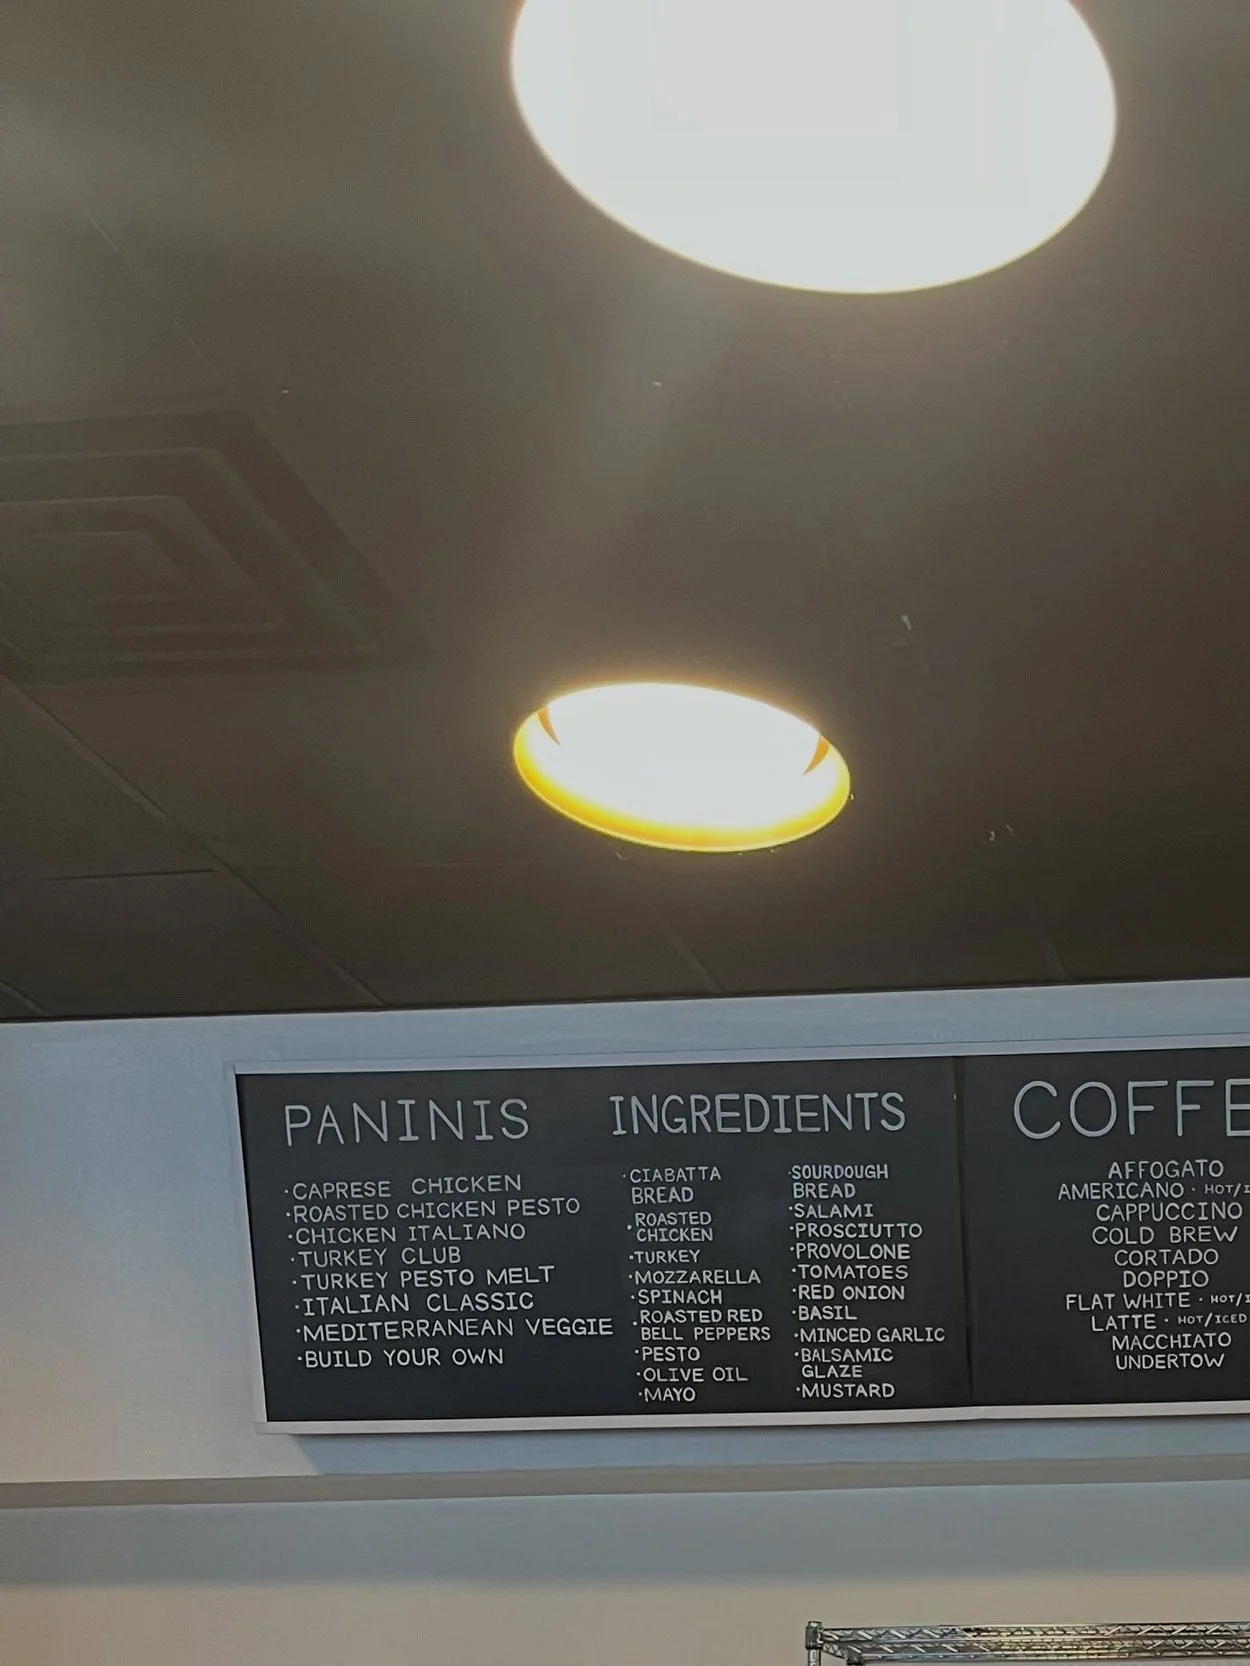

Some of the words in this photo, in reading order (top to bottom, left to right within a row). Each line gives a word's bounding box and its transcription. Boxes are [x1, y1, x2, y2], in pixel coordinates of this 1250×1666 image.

[284, 1098, 529, 1147] PANINIS
[608, 1092, 906, 1136] INGREDIENTS
[629, 1166, 722, 1184] CIABATTA
[791, 1163, 889, 1180] SOURDOUGH
[1107, 1158, 1224, 1180] AFFOGATO
[292, 1180, 392, 1201] CAPRESE
[411, 1174, 522, 1195] CHICKEN
[631, 1186, 694, 1205] BREAD
[792, 1181, 856, 1199] BREAD
[1057, 1181, 1185, 1201] AMERICANO
[293, 1203, 390, 1224] ROASTED
[396, 1199, 496, 1219] CHICKEN
[507, 1197, 580, 1217] PESTO
[634, 1211, 712, 1228] ROASTED
[794, 1202, 874, 1219] SALAMI
[1096, 1200, 1243, 1222] CAPPUCCINO
[295, 1226, 396, 1245] CHICKEN
[408, 1222, 526, 1242] ITALIANO
[636, 1227, 713, 1243] CHICKEN
[795, 1222, 923, 1239] PROSCIUTTO
[1092, 1225, 1155, 1245] COLD
[1169, 1225, 1238, 1244] BREW
[297, 1247, 387, 1268] TURKEY
[401, 1245, 461, 1265] CLUB
[633, 1249, 701, 1265] TURKEY
[795, 1242, 911, 1260] PROVOLONE
[1114, 1248, 1219, 1267] CORTADO
[300, 1271, 388, 1291] TURKEY
[400, 1268, 475, 1288] PESTO
[486, 1265, 555, 1286] MELT
[634, 1269, 762, 1286] MOZZARELLA
[797, 1263, 909, 1280] TOMATOES
[1123, 1269, 1210, 1289] DOPPIO
[637, 1288, 723, 1305] SPINACH
[798, 1283, 835, 1300] RED
[842, 1284, 905, 1301] ONION
[1066, 1293, 1116, 1311] FLAT
[1122, 1291, 1191, 1310] WHITE
[302, 1292, 410, 1317] ITALIAN
[426, 1291, 534, 1313] CLASSIC
[798, 1305, 858, 1321] BASIL
[639, 1309, 723, 1325] ROASTED
[727, 1308, 763, 1323] RED
[1091, 1313, 1157, 1332] LATTE
[1177, 1312, 1248, 1328] HOT/ICED
[303, 1318, 514, 1342] MEDITERRANEAN
[525, 1317, 614, 1336] VEGGIE
[641, 1326, 684, 1341] BELL
[693, 1326, 771, 1341] PEPPERS
[800, 1327, 872, 1344] MINCED
[876, 1326, 946, 1343] GARLIC
[1112, 1331, 1232, 1351] MACCHIATO
[305, 1349, 372, 1368] BUILD
[383, 1347, 441, 1367] YOUR
[451, 1347, 504, 1366] OWN
[641, 1346, 701, 1362] PESTO
[800, 1347, 894, 1363] BALSAMIC
[1115, 1352, 1225, 1370] UNDERTOW
[643, 1367, 705, 1383] OLIVE
[712, 1366, 749, 1382] OIL
[801, 1364, 863, 1379] GLAZE
[644, 1386, 696, 1403] MAYO
[802, 1382, 895, 1399] MUSTARD
